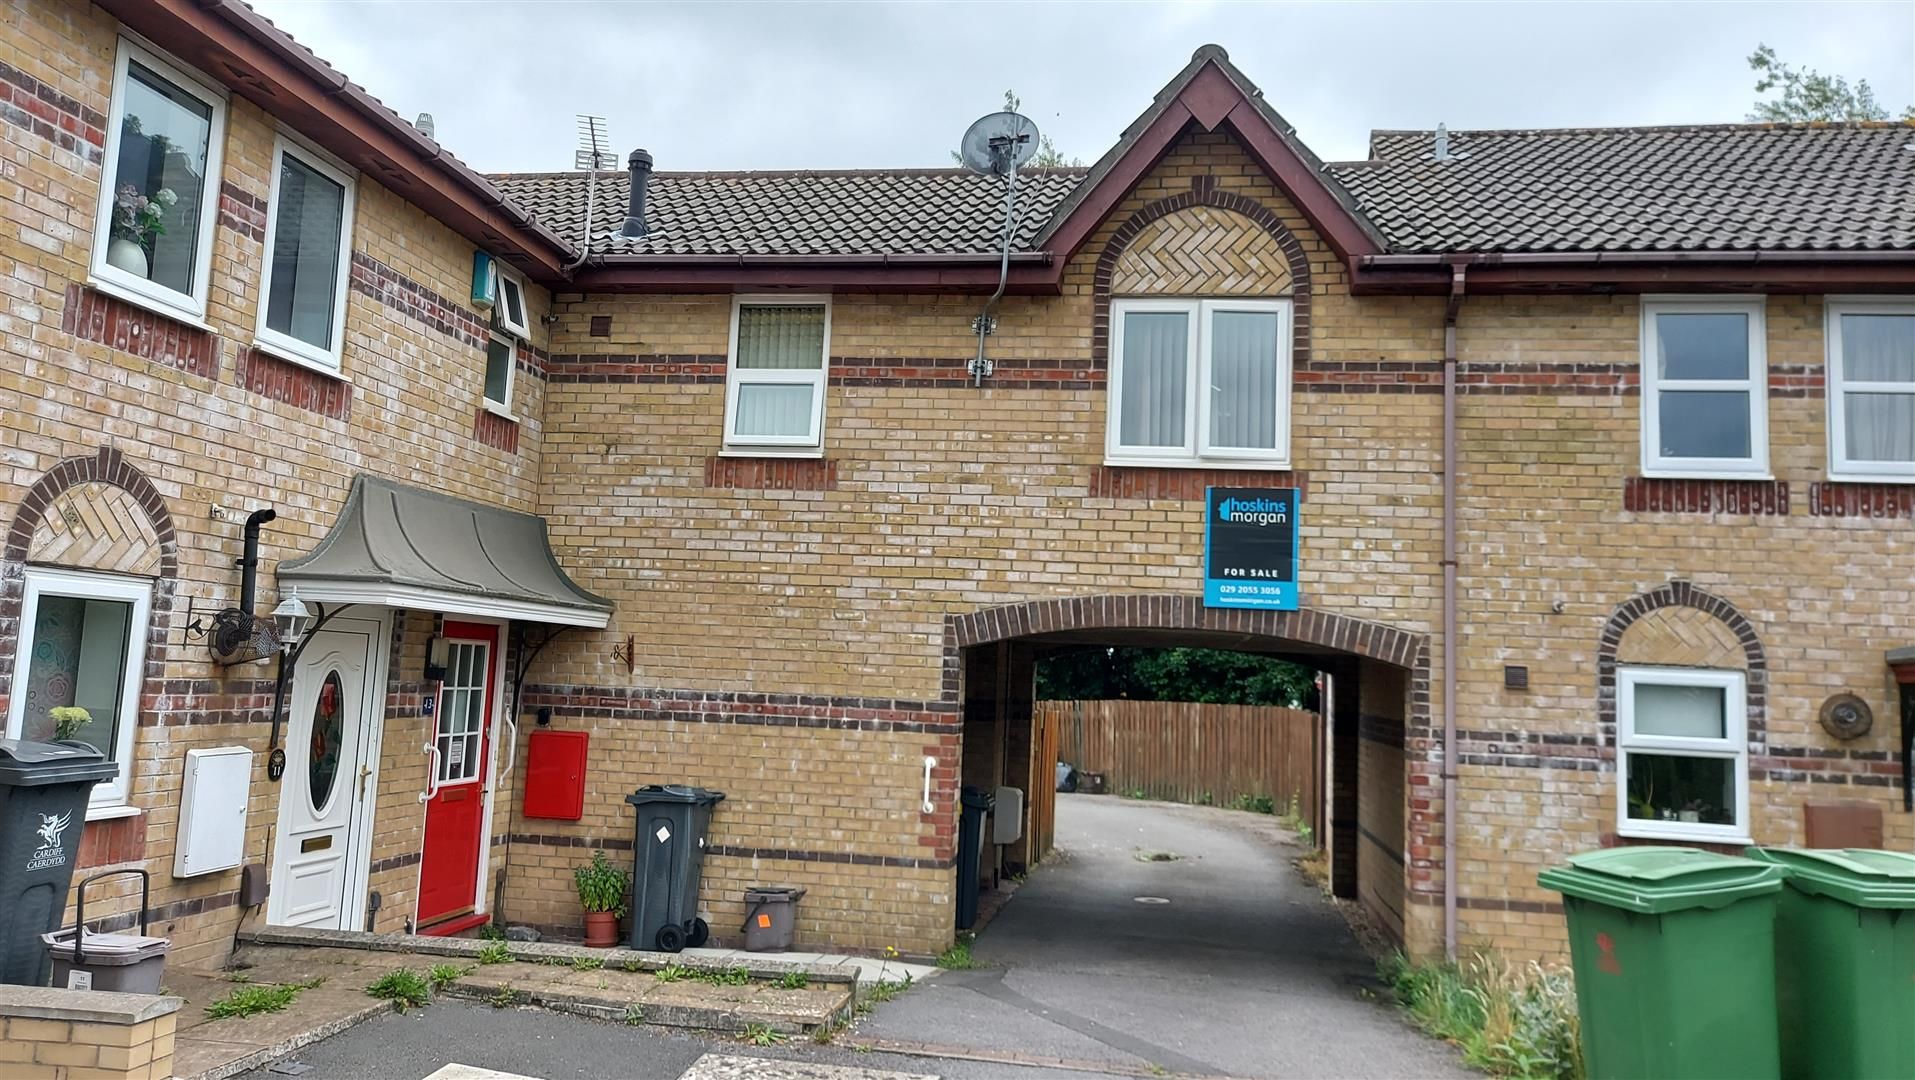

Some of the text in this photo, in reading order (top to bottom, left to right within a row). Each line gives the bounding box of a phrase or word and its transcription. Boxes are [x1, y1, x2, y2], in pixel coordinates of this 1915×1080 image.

[1231, 497, 1286, 513] hoskins
[1230, 511, 1286, 526] morgan
[1224, 568, 1278, 578] FOR SALE
[1219, 585, 1281, 595] 029 2055 3056
[425, 698, 433, 709] 13
[273, 766, 281, 776] 11
[33, 847, 64, 859] CARDIFF
[26, 856, 66, 869] CAERDYDD
